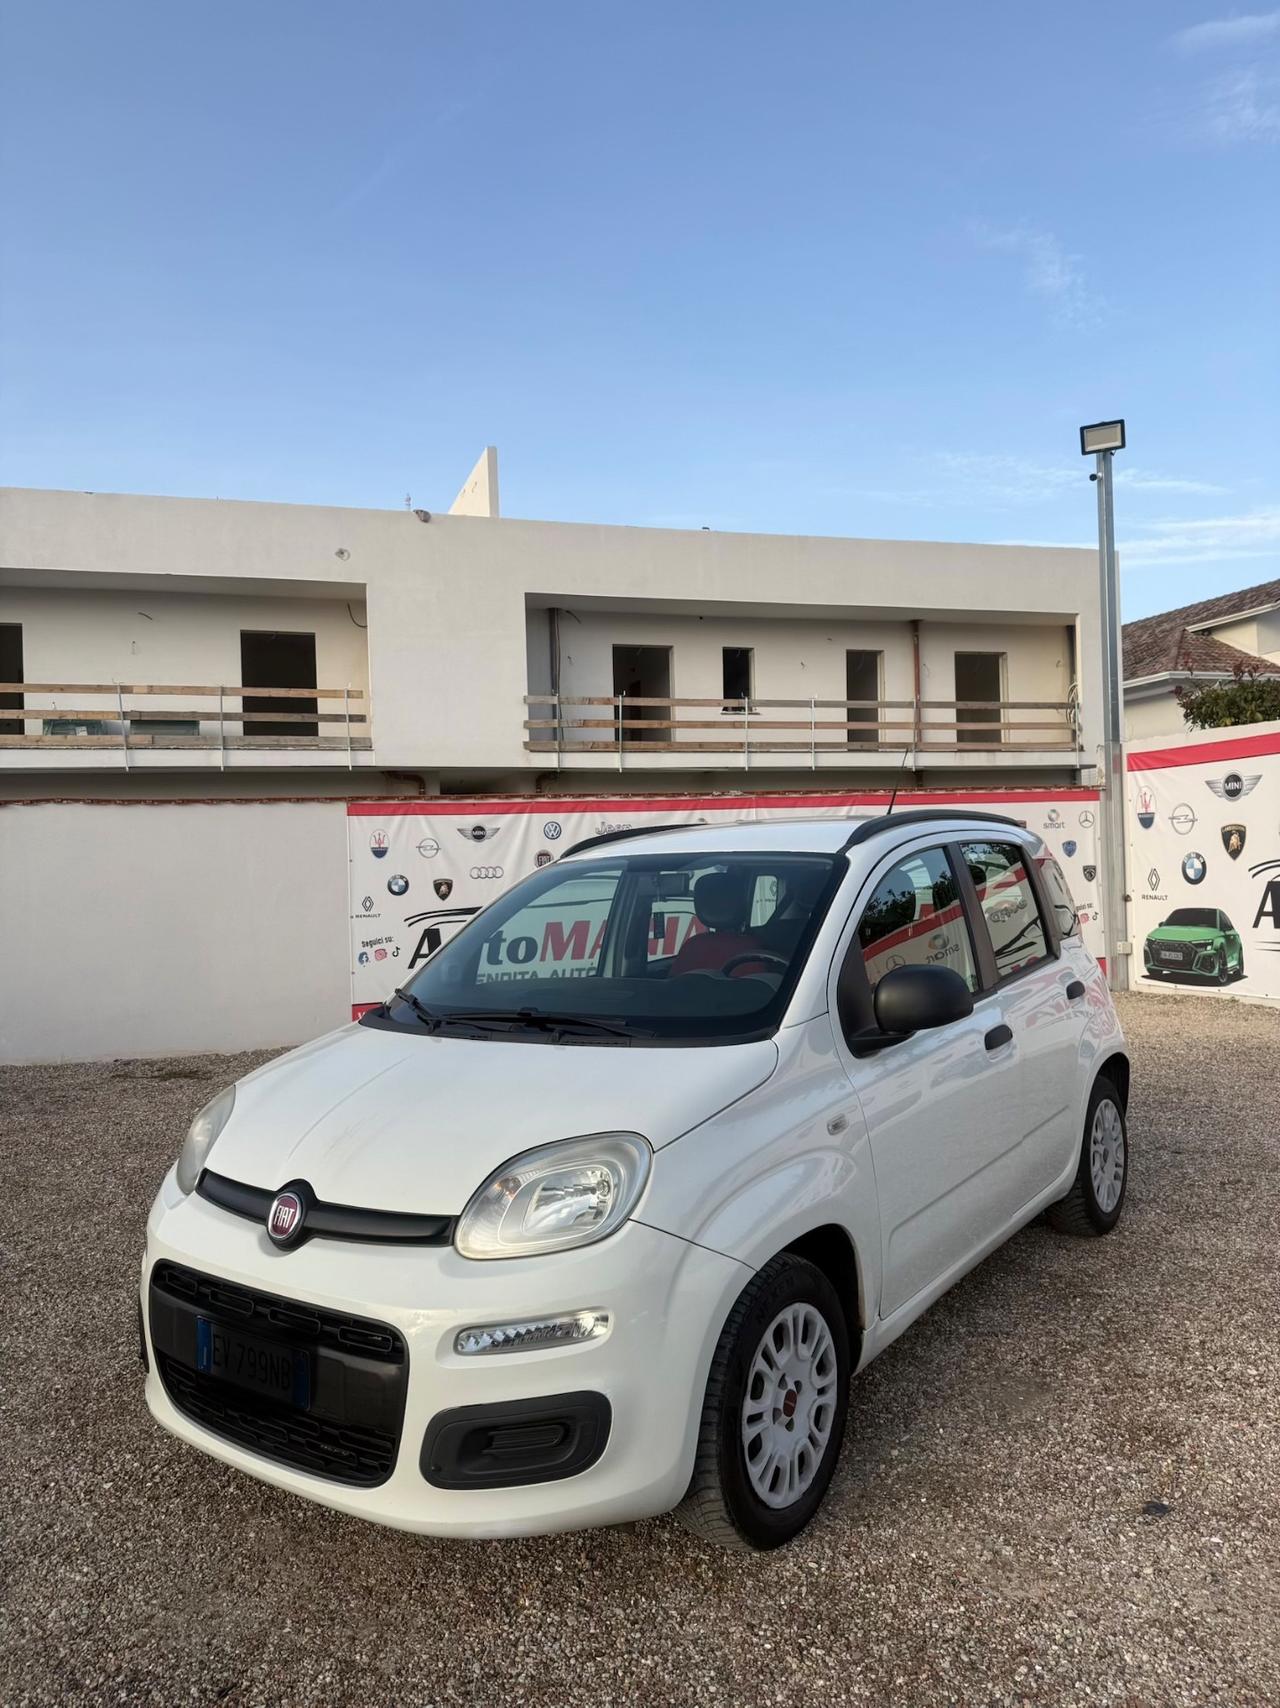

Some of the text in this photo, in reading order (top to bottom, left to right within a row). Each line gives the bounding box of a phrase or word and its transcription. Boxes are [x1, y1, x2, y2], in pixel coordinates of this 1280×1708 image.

[1224, 781, 1242, 790] MINI
[1043, 821, 1065, 829] smart
[361, 937, 384, 948] Seguici
[273, 1204, 295, 1229] FIAT
[213, 1333, 232, 1369] EV
